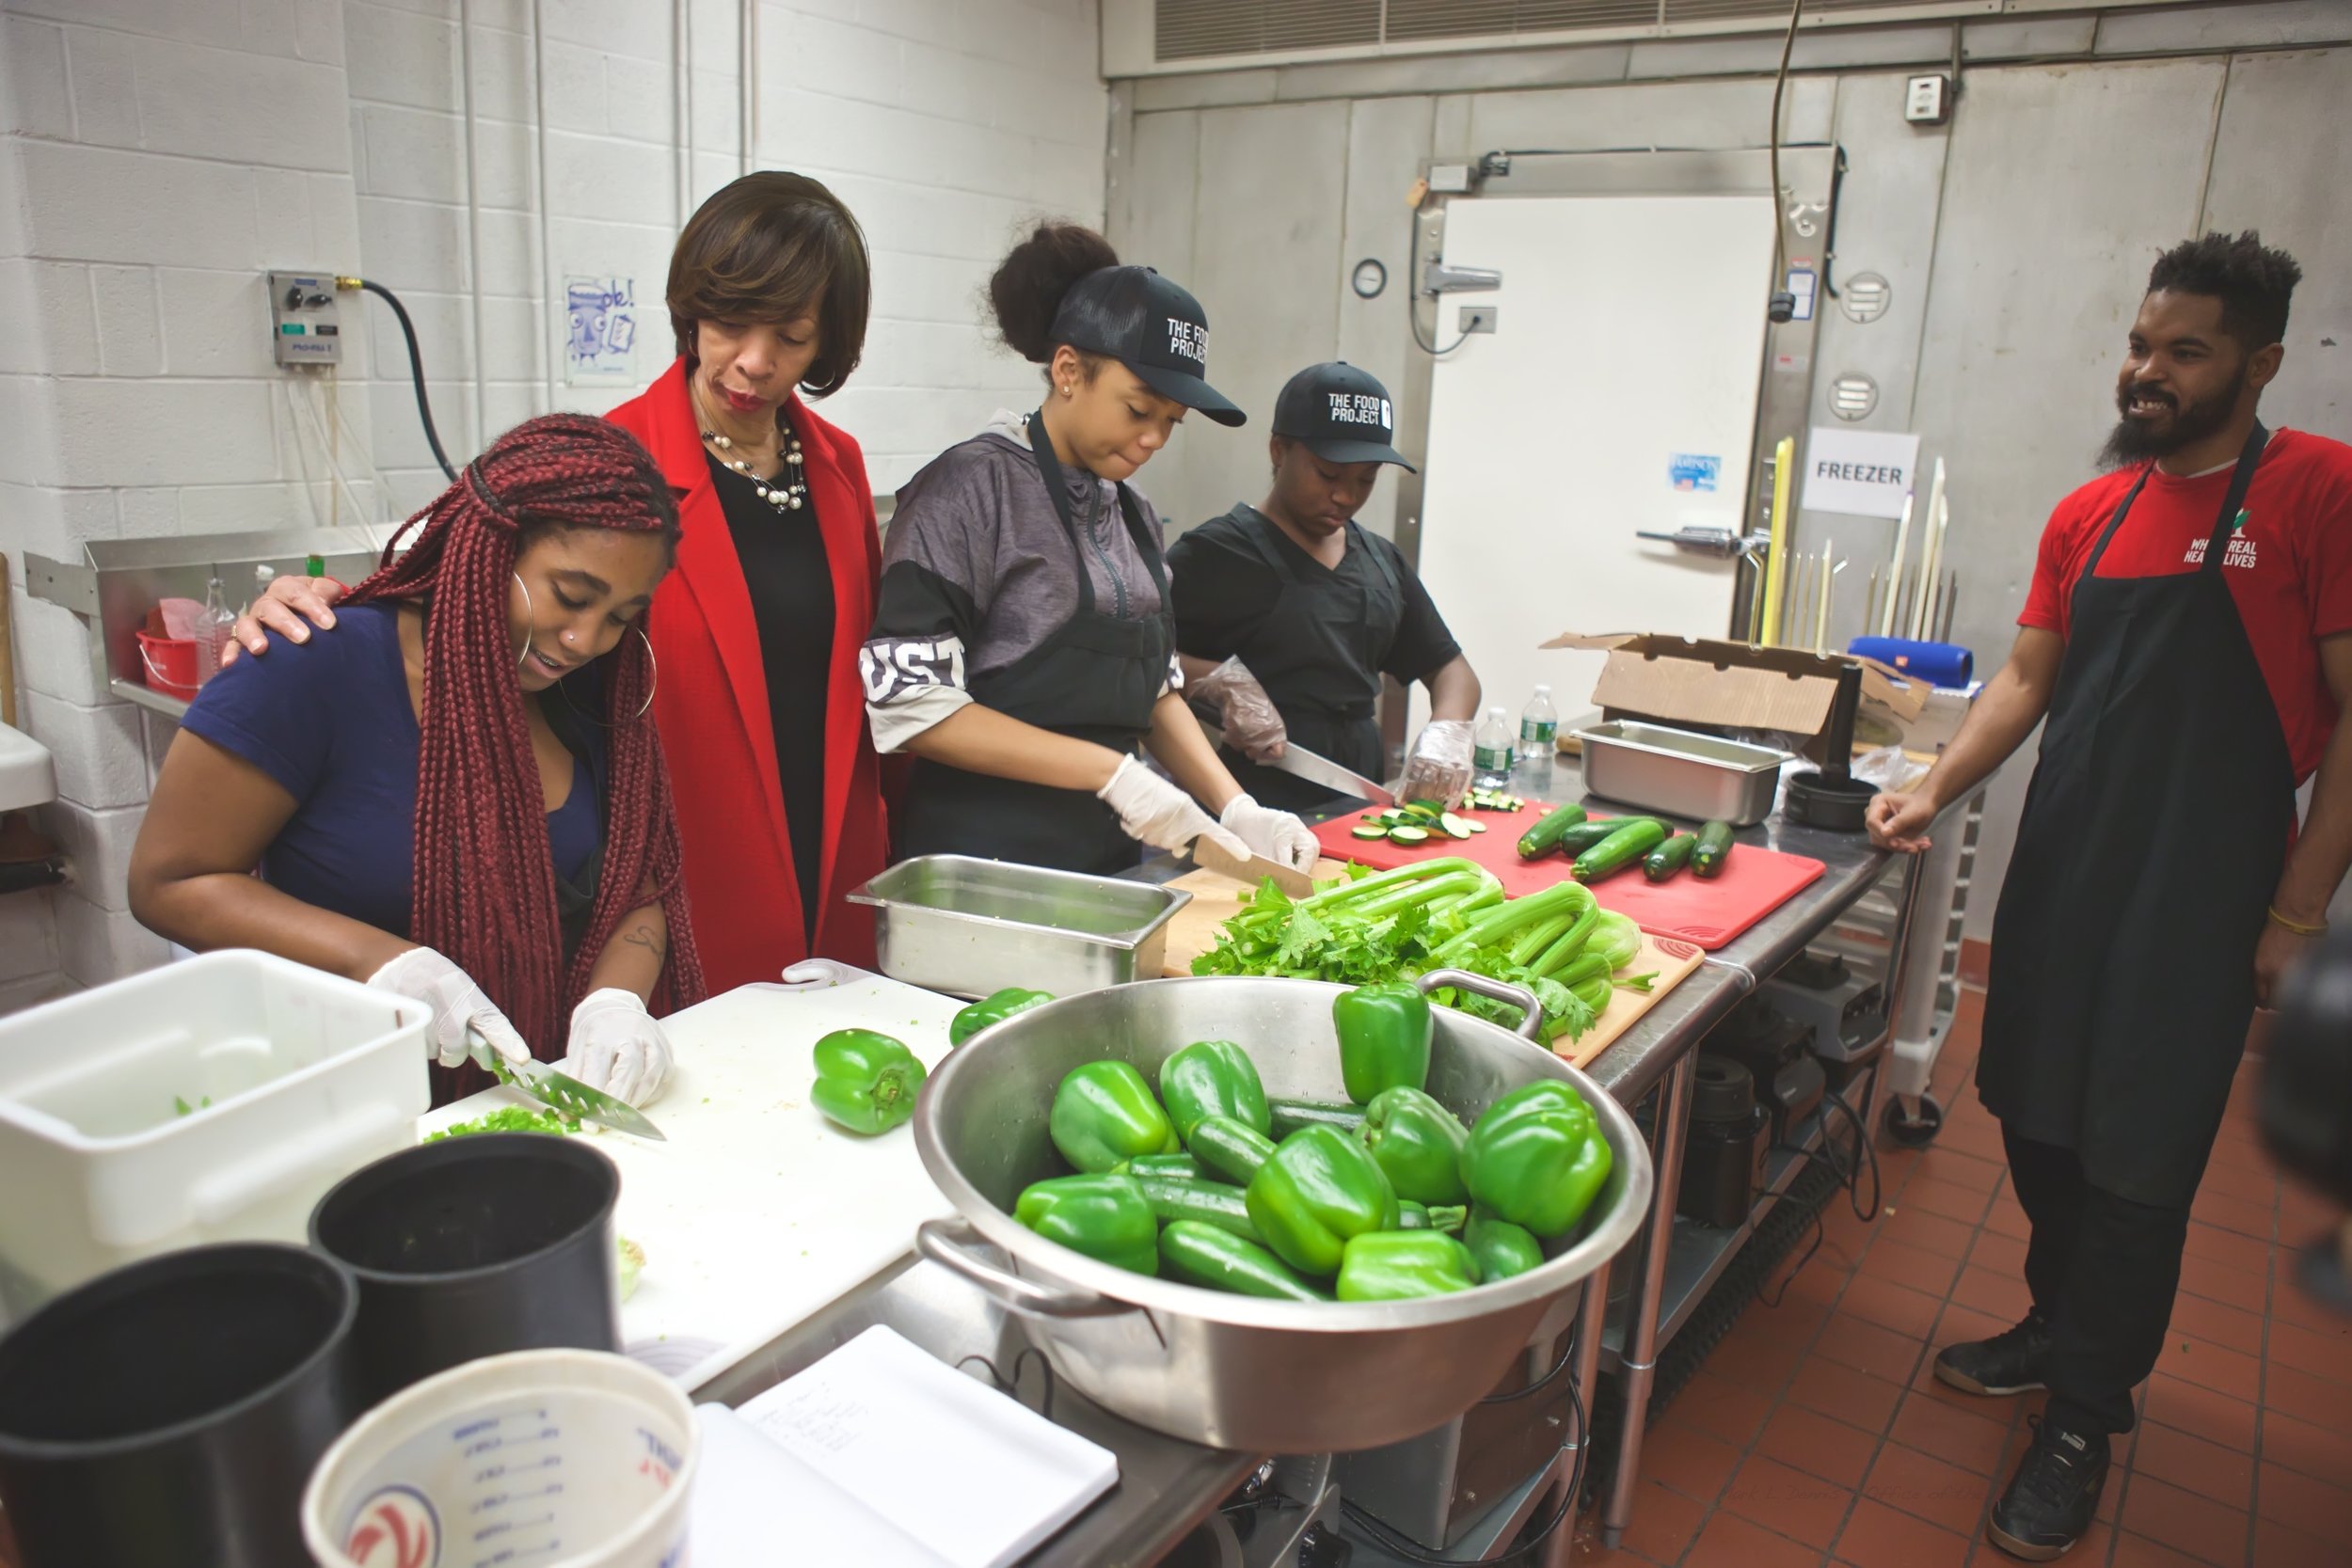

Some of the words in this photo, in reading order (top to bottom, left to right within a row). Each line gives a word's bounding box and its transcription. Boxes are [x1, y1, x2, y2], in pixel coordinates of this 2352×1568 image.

[1167, 318, 1192, 340] THE
[1328, 392, 1351, 408] THE
[1355, 395, 1380, 411] FOOD
[1331, 407, 1380, 425] PROJECT
[1817, 461, 1902, 485] FREEZER
[2227, 540, 2257, 555] REAL
[2222, 553, 2256, 568] LIVES
